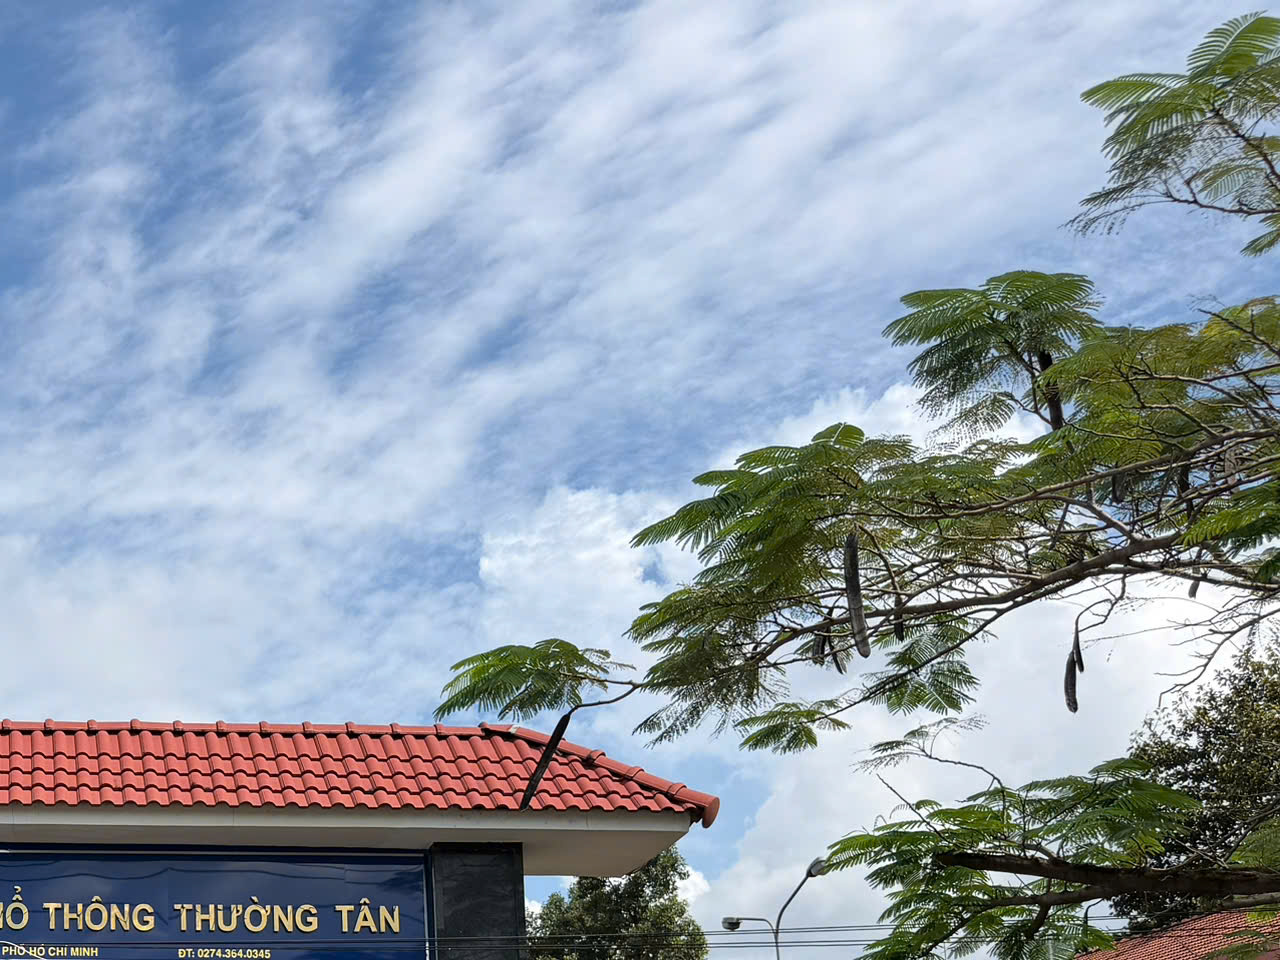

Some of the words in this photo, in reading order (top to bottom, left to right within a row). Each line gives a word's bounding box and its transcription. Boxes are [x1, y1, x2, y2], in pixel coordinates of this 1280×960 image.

[42, 895, 155, 932] THÔNG
[173, 896, 319, 933] THƯỜNG
[335, 897, 401, 934] TÂN
[178, 949, 195, 959] ĐT:
[197, 948, 271, 960] 0274.364.0345
